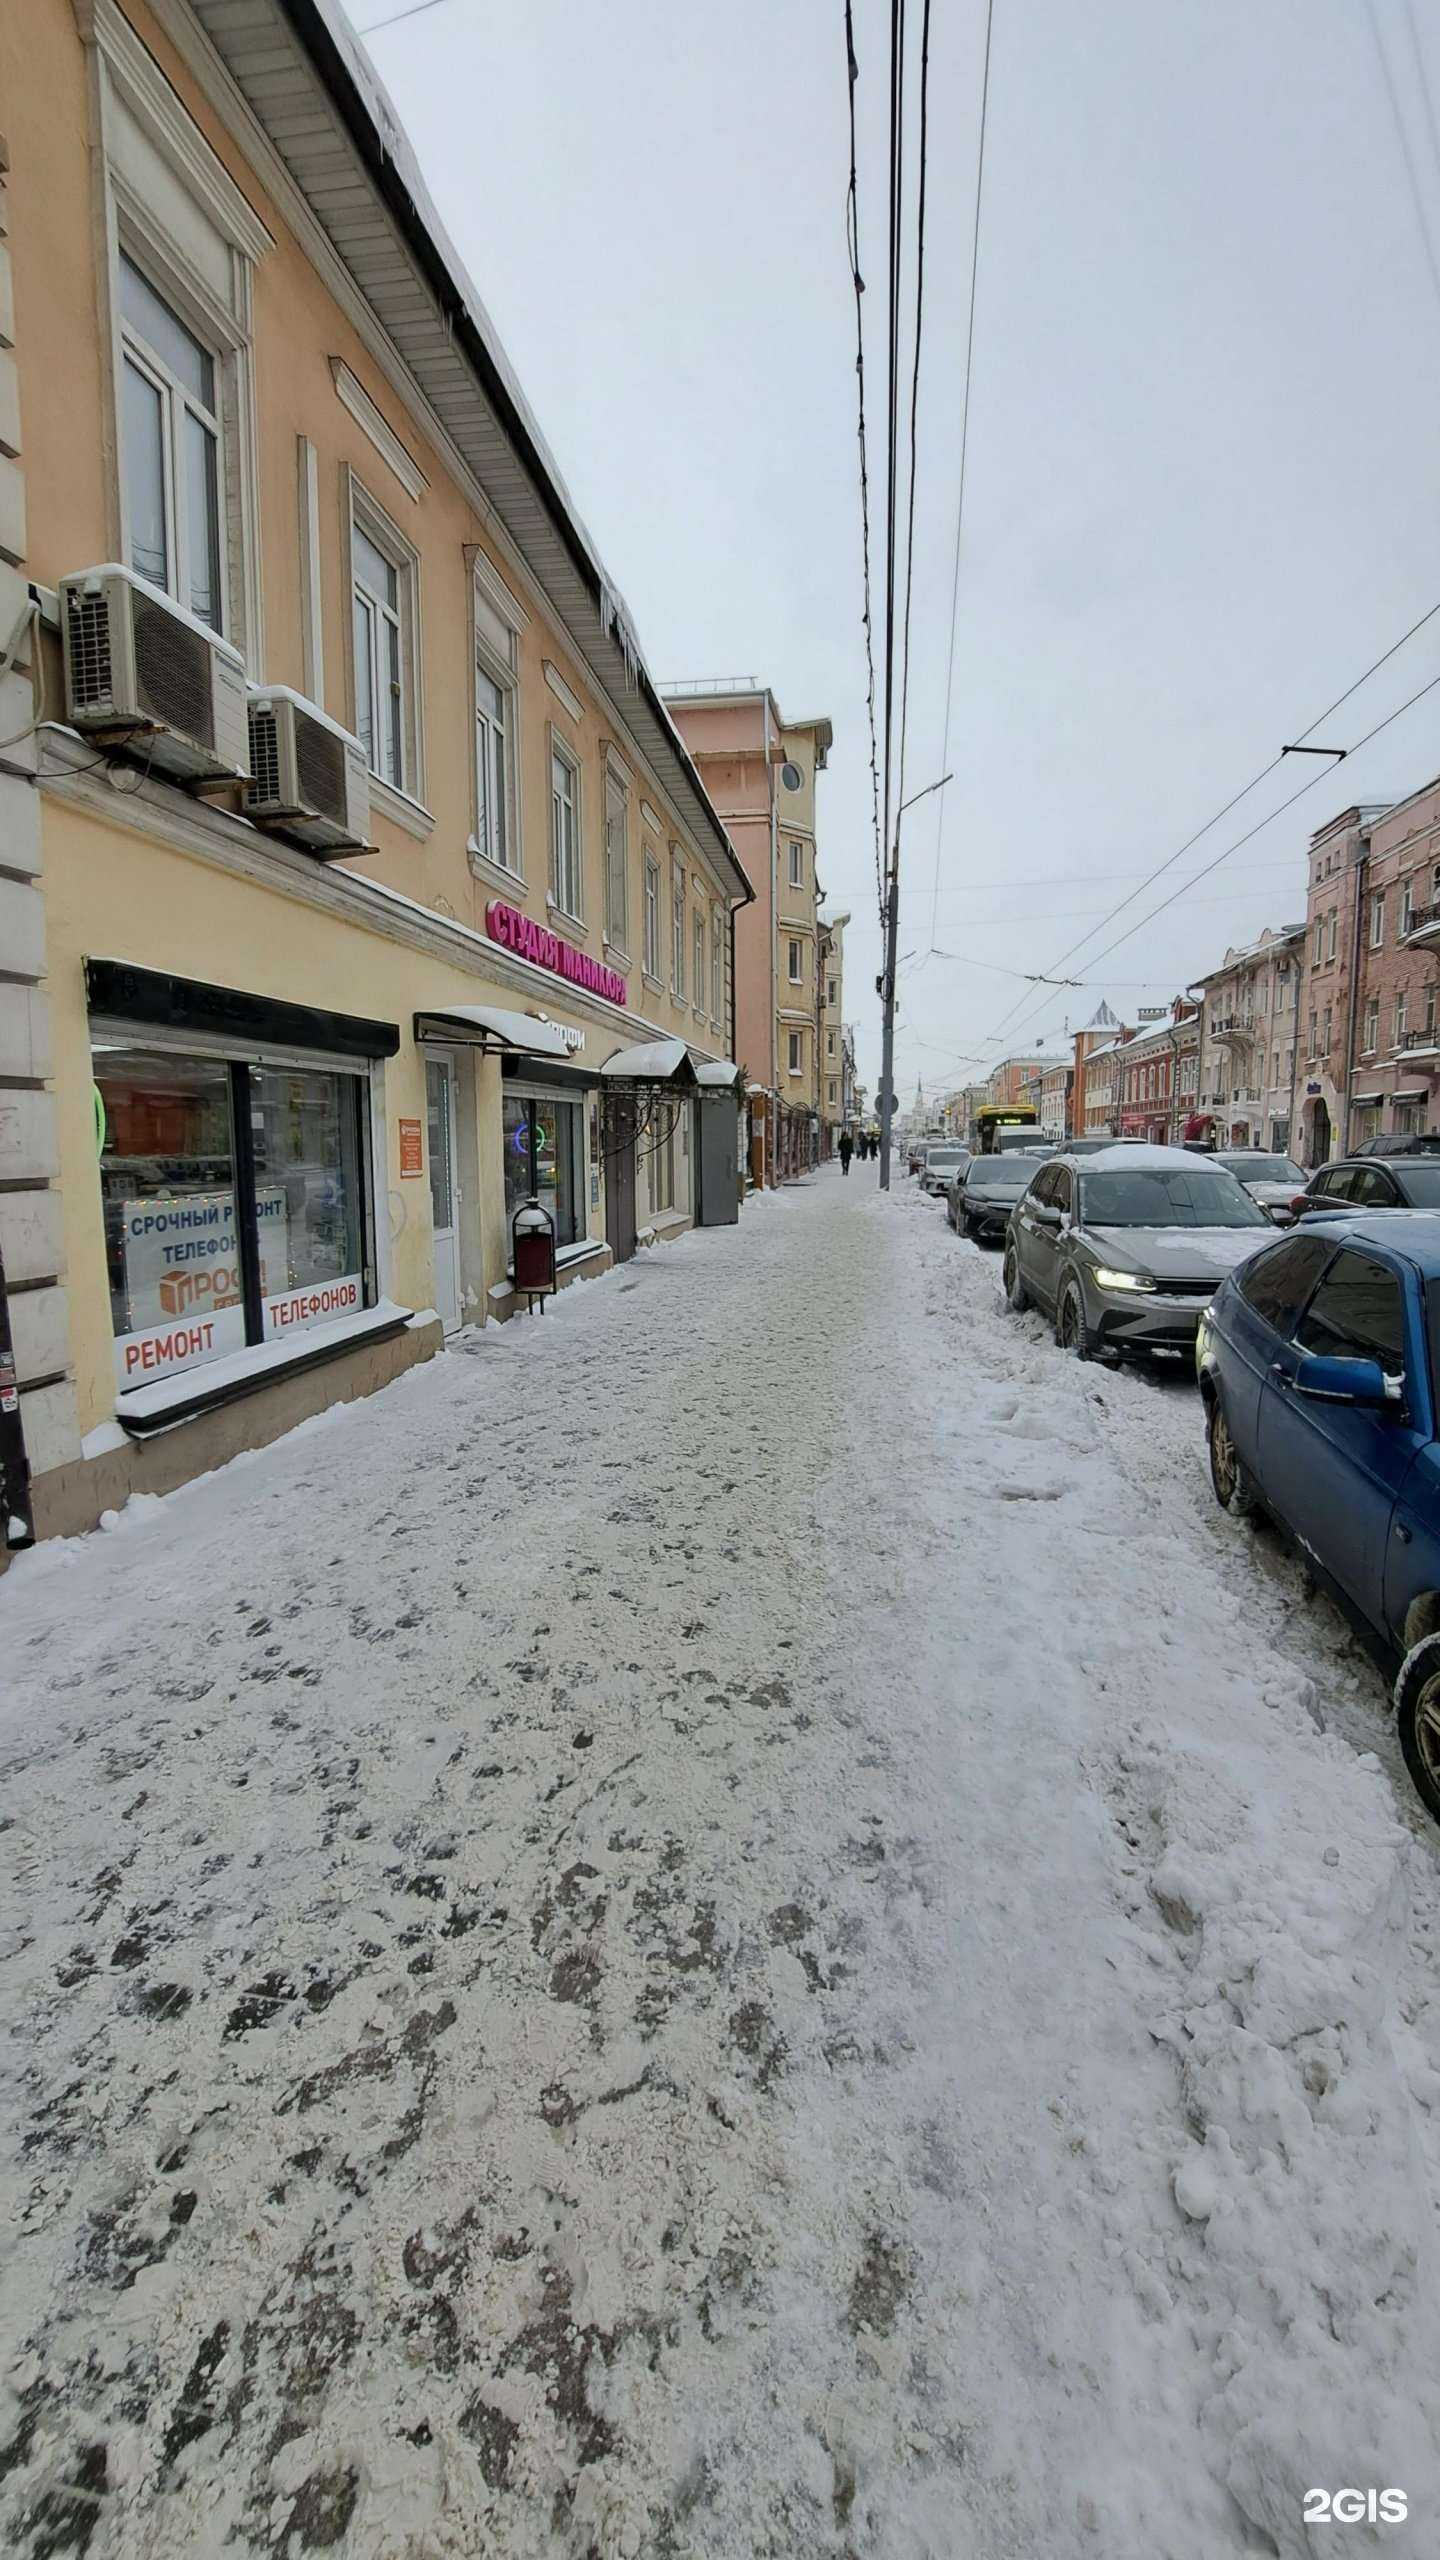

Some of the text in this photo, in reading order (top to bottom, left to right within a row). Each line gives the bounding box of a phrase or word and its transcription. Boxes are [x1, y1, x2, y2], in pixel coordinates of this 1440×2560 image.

[488, 901, 627, 1006] СТУДИЯ МАНИКЮРА
[131, 1200, 283, 1236] СРОЧНЫЙ РОНТ
[125, 1323, 215, 1374] РЕМОНТ
[269, 1284, 357, 1328] ТЕЛЕФОНОВ
